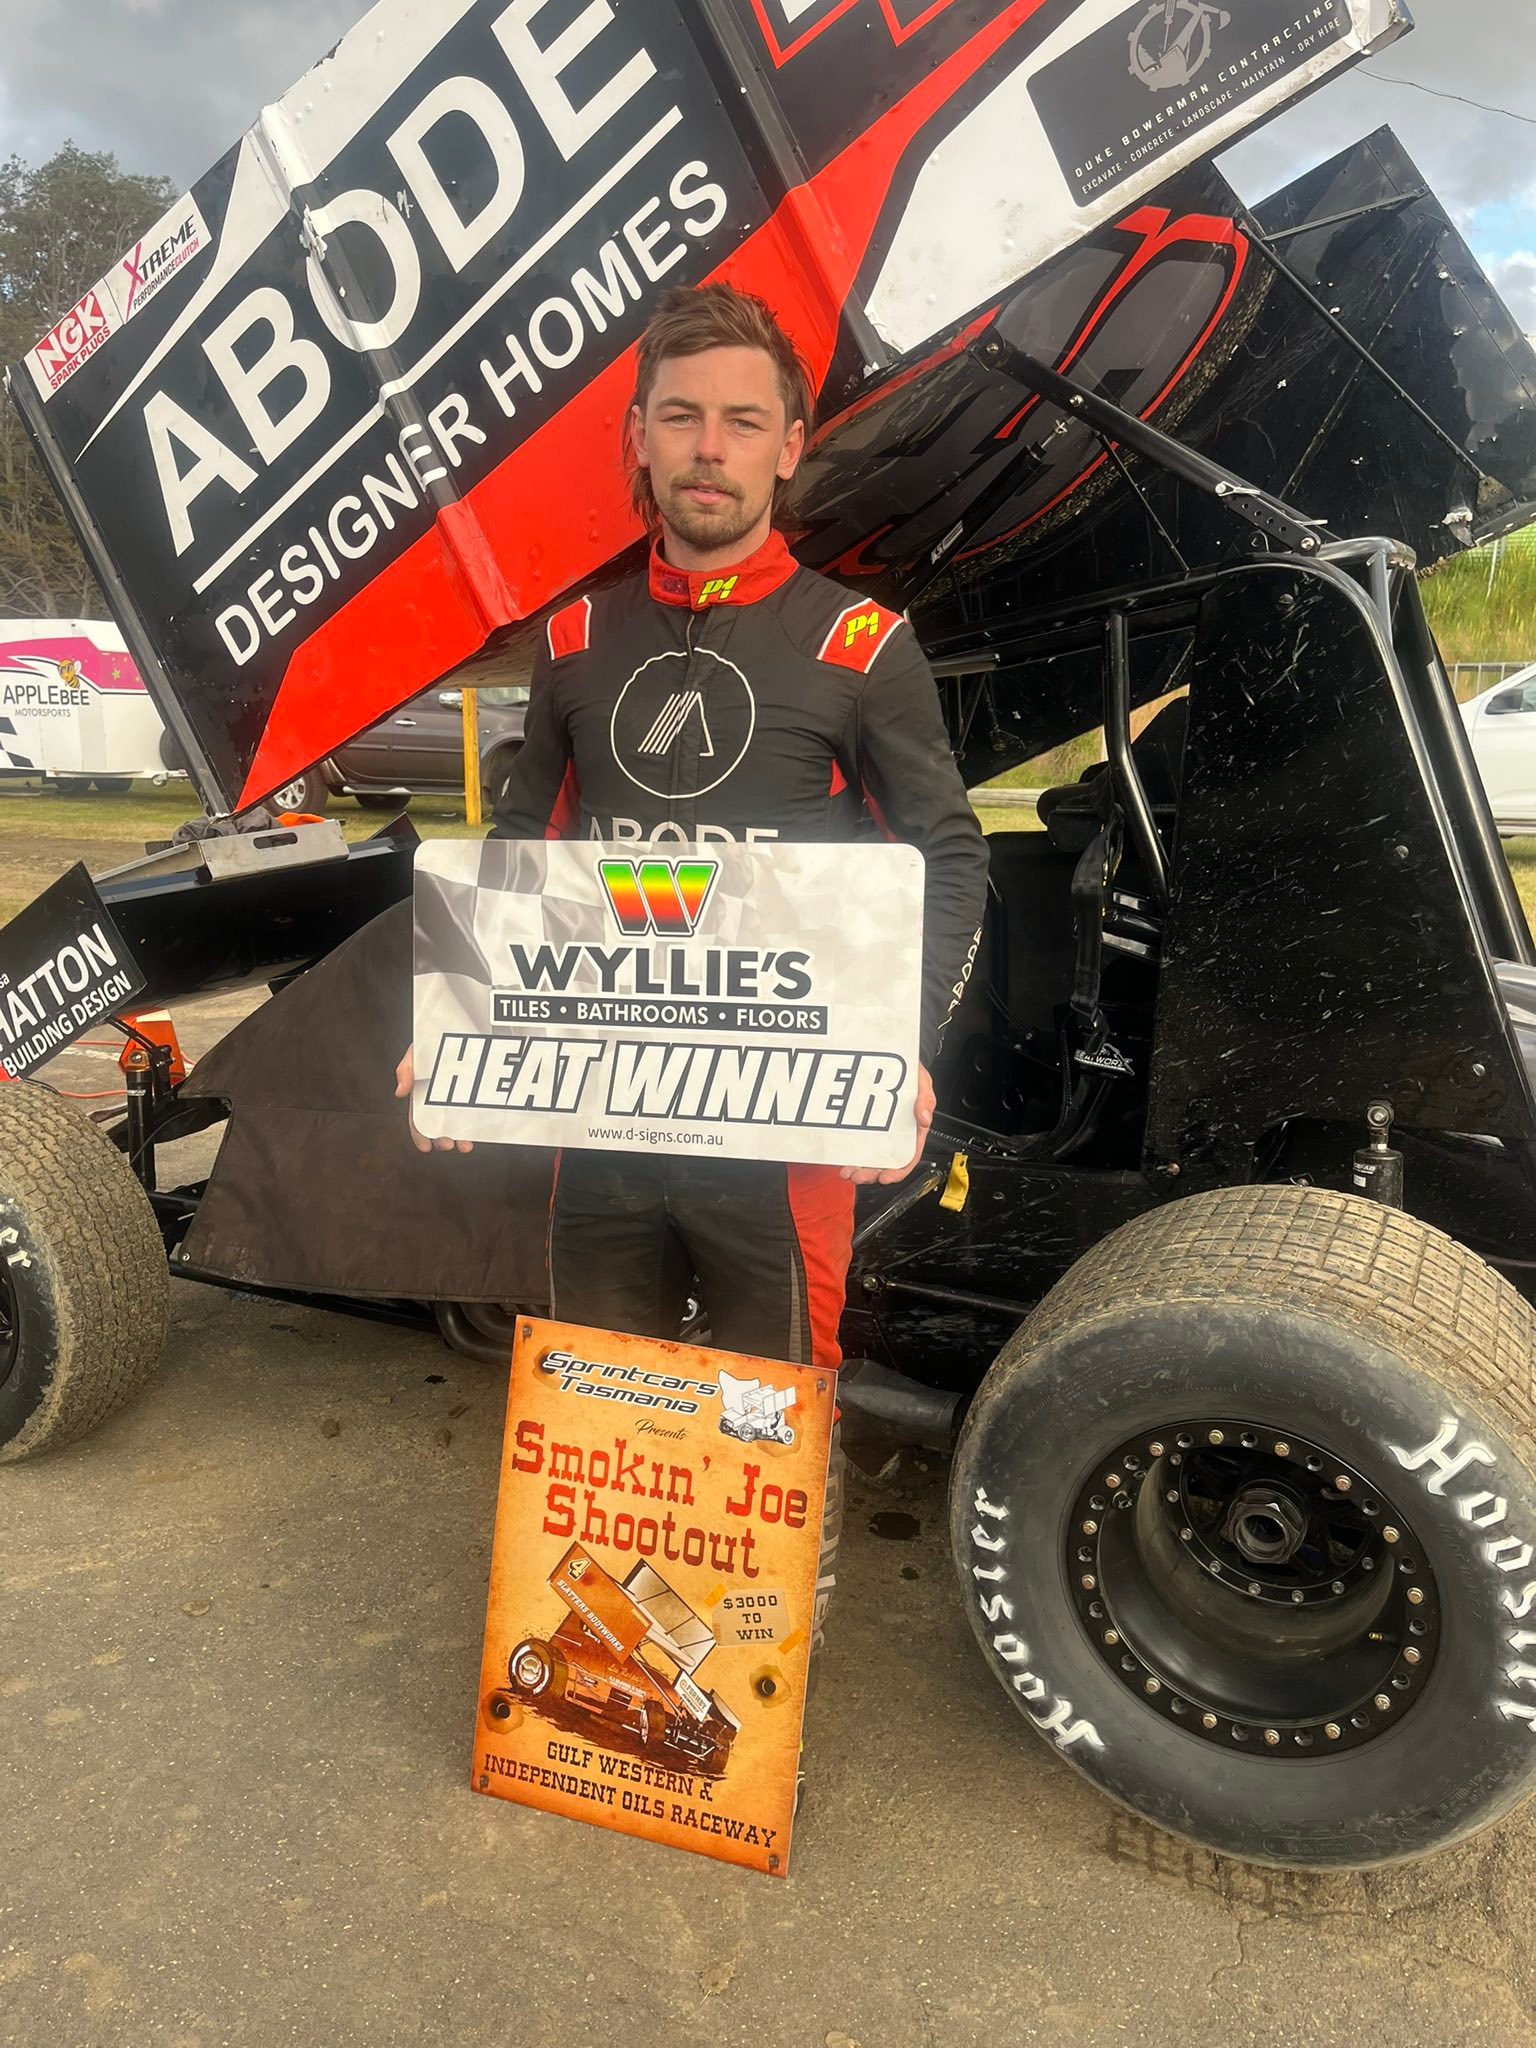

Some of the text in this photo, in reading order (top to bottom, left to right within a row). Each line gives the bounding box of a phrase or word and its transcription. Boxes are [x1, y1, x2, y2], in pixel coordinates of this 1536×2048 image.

[1075, 0, 1333, 178] DUKE BOWERMAN CONTRACTING
[1082, 17, 1341, 194] EXCAVATE CONCRETE LANDSCAPE MAINTAIN DRY HIRE
[123, 214, 197, 322] XTREME
[143, 0, 657, 557] ABODE
[36, 294, 104, 379] NGK
[50, 326, 111, 390] SPARK PLUGS
[214, 159, 729, 667] DESIGNER HOMES
[3, 684, 91, 706] APPLEBEE
[15, 708, 71, 718] MOTORSPORTS
[509, 943, 812, 999] WYLLIE'S
[2, 970, 133, 1078] BUILDING DESIGN
[500, 999, 821, 1030] TILES BATHROOMS FLOORS
[425, 1033, 907, 1131] HEAT WINNER
[587, 1126, 724, 1146] www.d-signs.com.au
[542, 1351, 719, 1397] Sprintcars
[559, 1373, 700, 1415] Tasmania
[634, 1418, 689, 1441] Presents
[512, 1419, 808, 1529] Smokin' Joe
[543, 1483, 760, 1579] Shootout
[567, 1557, 592, 1581] 4
[556, 1579, 588, 1614] SLATTERS
[586, 1611, 625, 1653] BODYWORKS
[723, 1593, 779, 1610] $3000
[742, 1611, 762, 1625] TO
[736, 1626, 774, 1641] WIN
[483, 1753, 777, 1848] INDEPENDENT OILS RACEWAY
[547, 1741, 713, 1802] GULF WESTERN &
